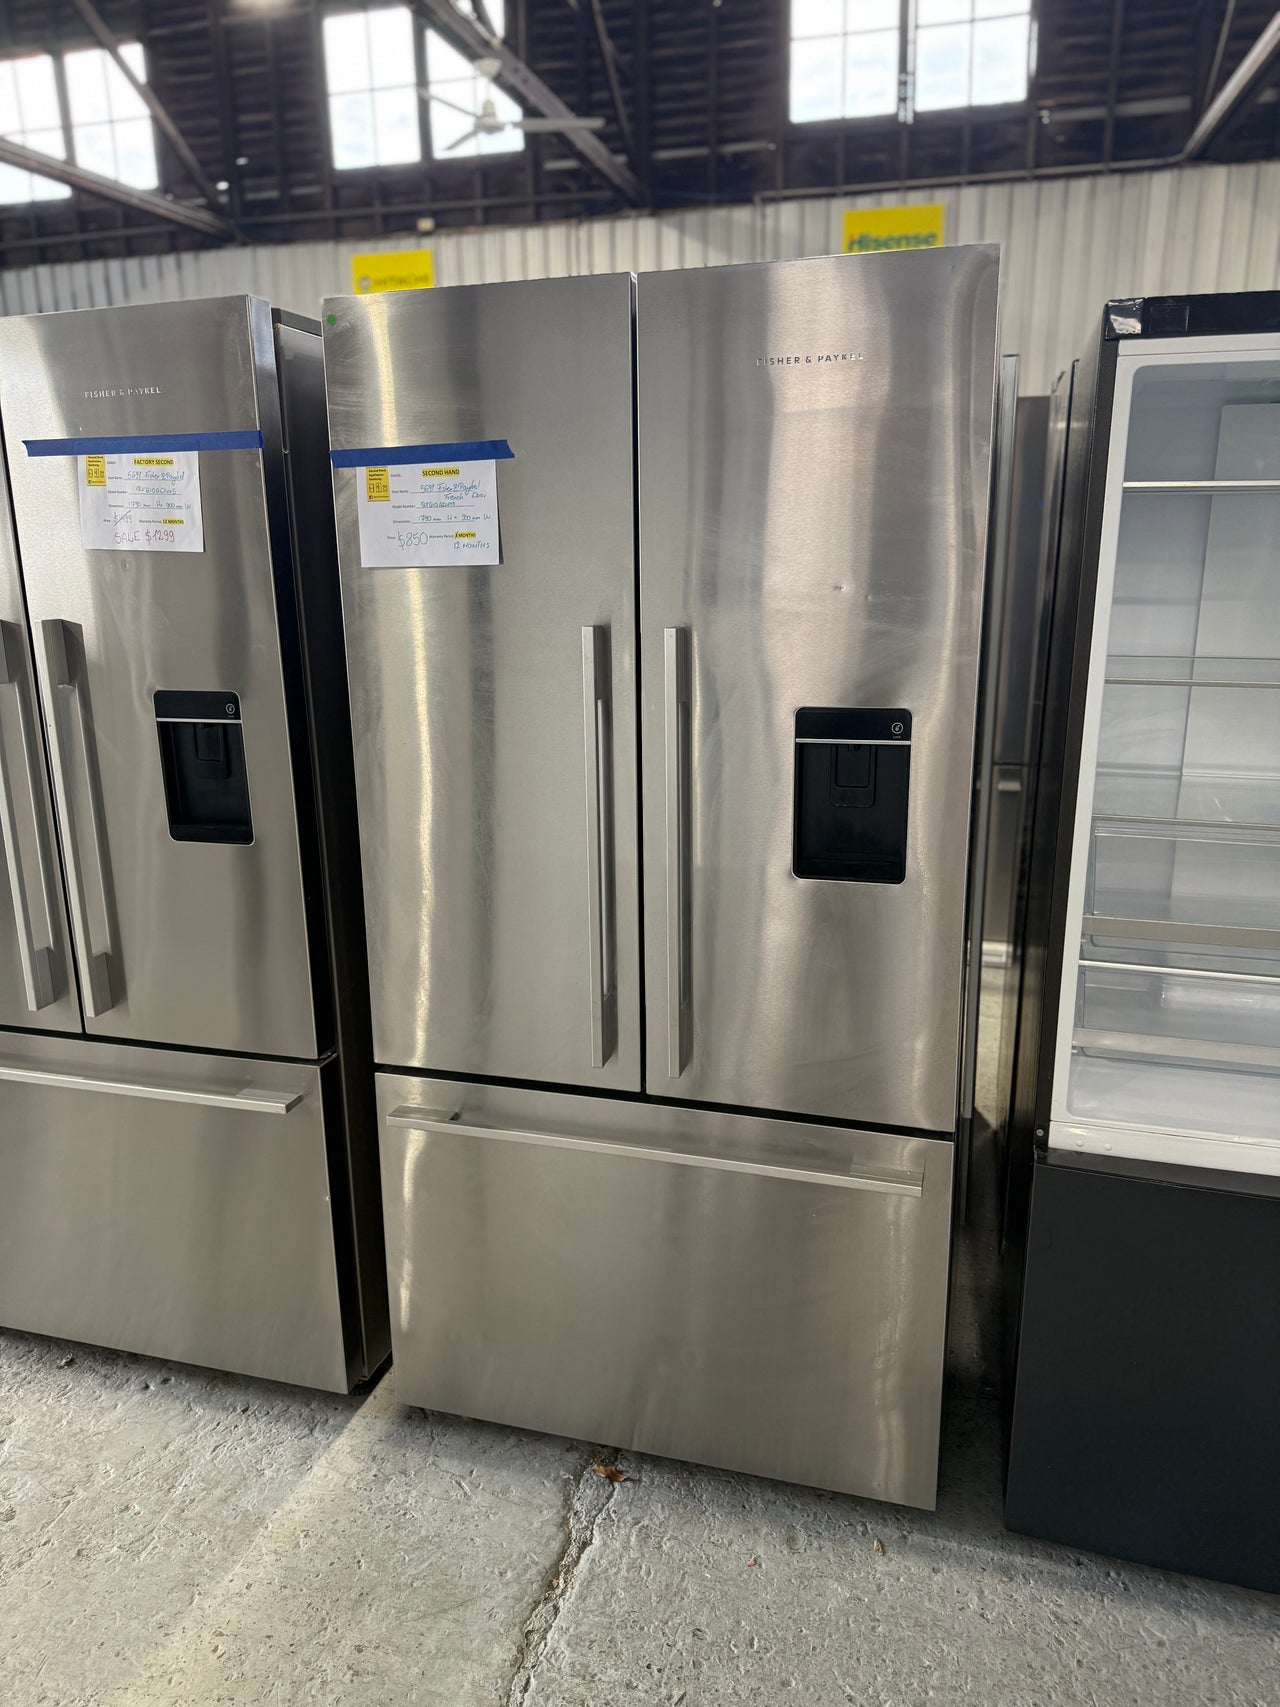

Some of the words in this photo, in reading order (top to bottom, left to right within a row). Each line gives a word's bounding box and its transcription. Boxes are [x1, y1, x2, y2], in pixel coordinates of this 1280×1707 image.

[756, 356, 800, 366] FISHER
[818, 353, 863, 362] PAYKEL
[84, 390, 116, 398] FISHER
[128, 386, 161, 395] PAYKEL
[114, 531, 141, 544] SALE
[145, 529, 174, 545] $1299
[397, 531, 429, 550] $850
